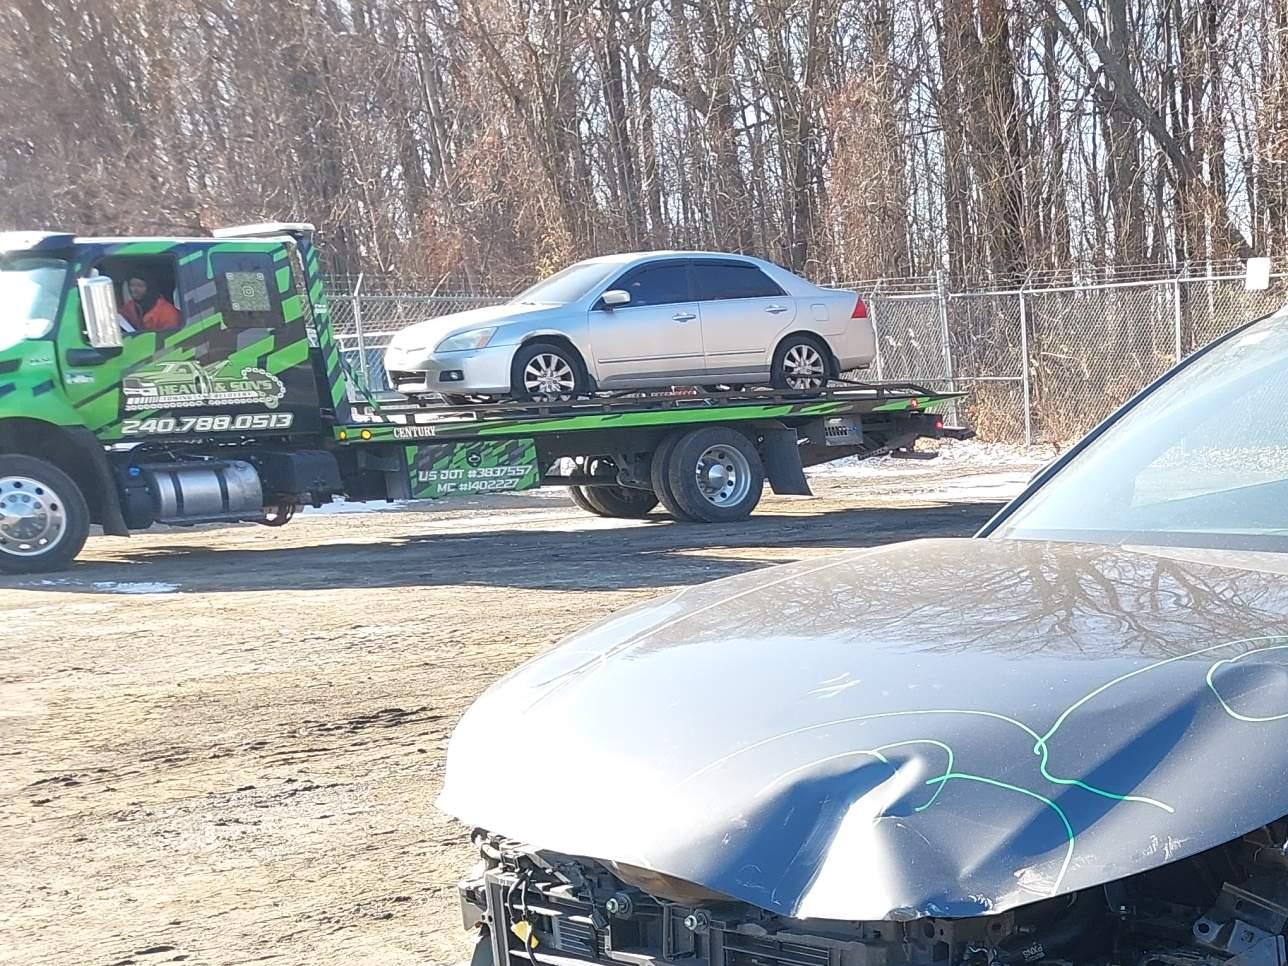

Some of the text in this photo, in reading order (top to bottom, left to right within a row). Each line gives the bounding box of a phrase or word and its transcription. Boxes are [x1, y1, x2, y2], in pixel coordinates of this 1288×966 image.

[215, 382, 227, 392] &
[121, 413, 294, 434] 240.788.0513
[393, 425, 437, 438] CENTURY
[418, 465, 533, 481] US DOT #3837557
[437, 478, 520, 493] MC #1402227
